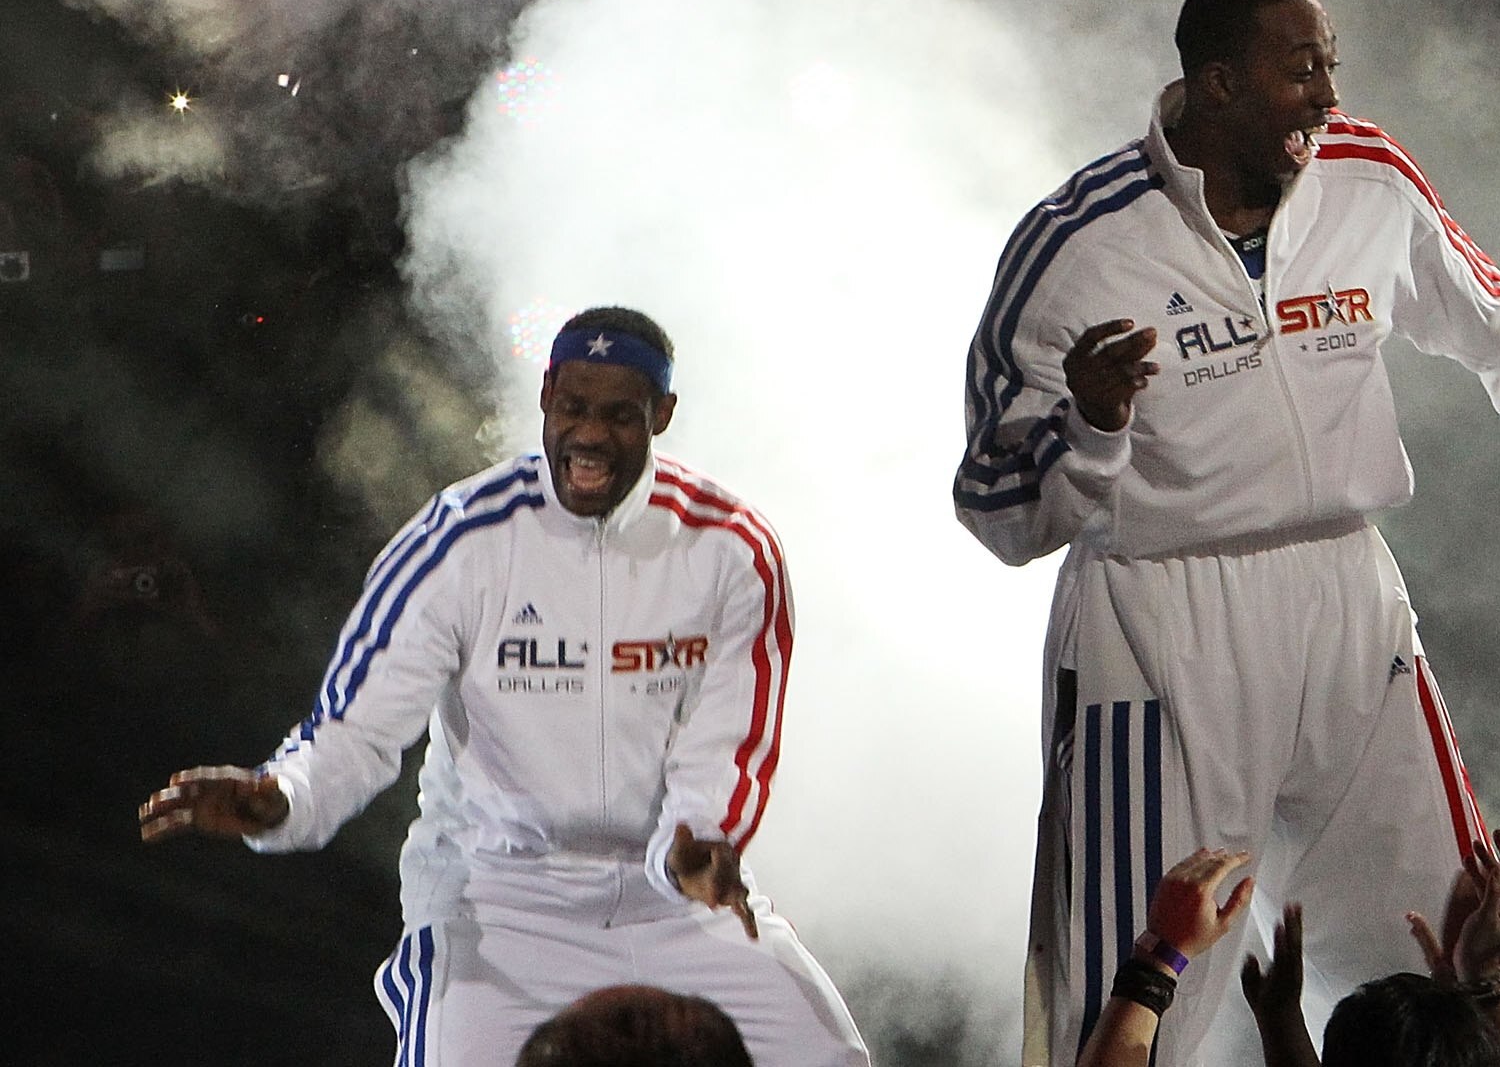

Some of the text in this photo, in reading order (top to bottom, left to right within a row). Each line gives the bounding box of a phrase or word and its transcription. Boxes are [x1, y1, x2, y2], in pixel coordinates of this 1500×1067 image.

[1175, 282, 1375, 360] ALL STAR
[1316, 333, 1357, 351] 2010
[1183, 354, 1263, 387] DALLAS
[498, 629, 708, 673] ALL STAR
[498, 676, 584, 693] DALLAS
